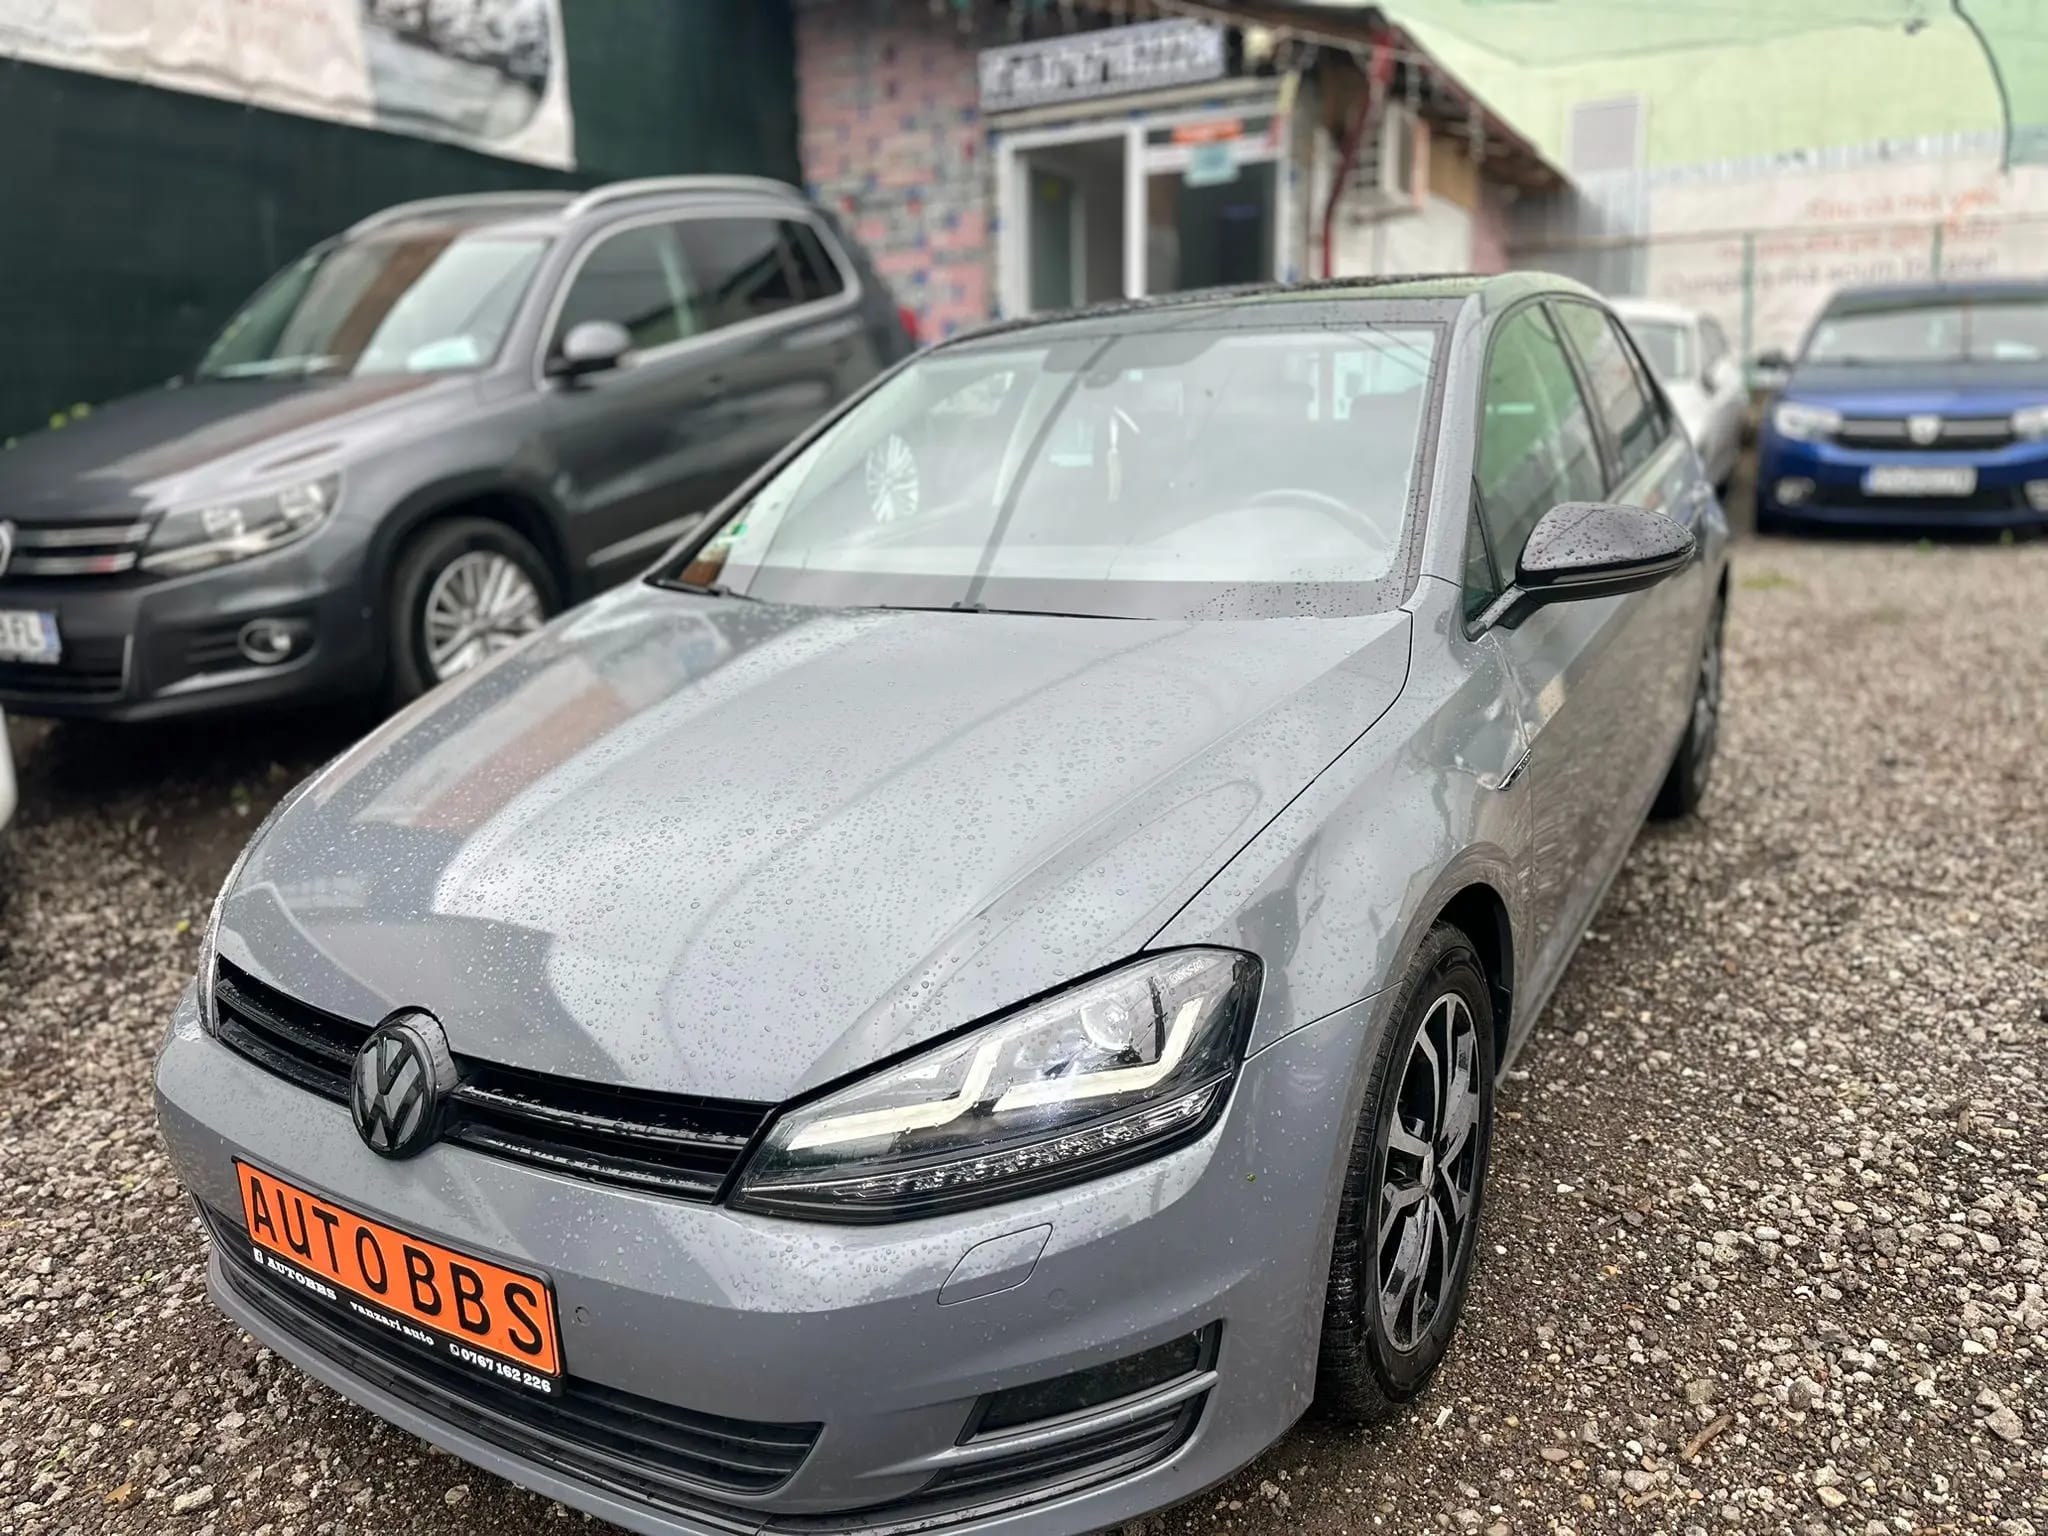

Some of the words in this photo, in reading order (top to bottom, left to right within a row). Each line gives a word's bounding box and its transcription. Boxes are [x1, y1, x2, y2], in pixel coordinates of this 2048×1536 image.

[267, 1255, 337, 1300] AUTOBBS
[350, 1301, 402, 1331] vanzari
[403, 1326, 435, 1346] auto
[461, 1348, 494, 1371] 0767
[496, 1361, 522, 1382] 162
[523, 1372, 552, 1393] 226
